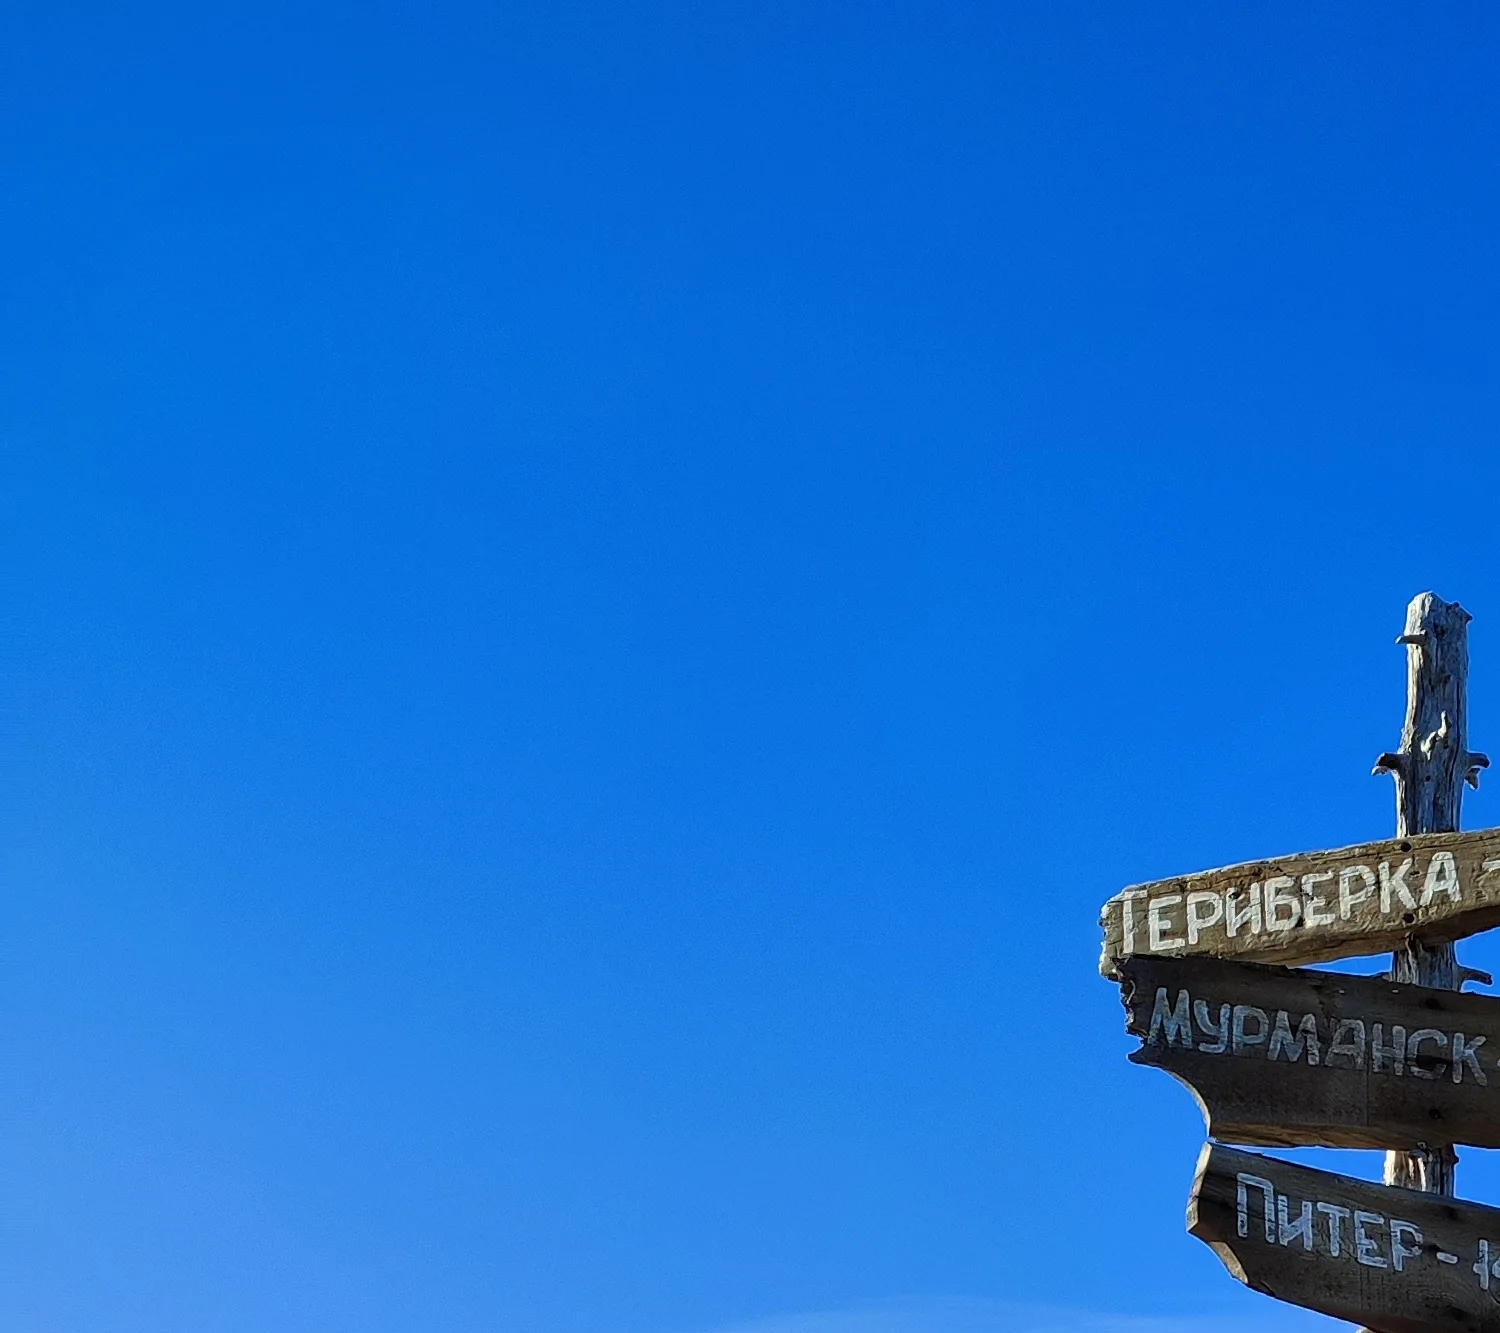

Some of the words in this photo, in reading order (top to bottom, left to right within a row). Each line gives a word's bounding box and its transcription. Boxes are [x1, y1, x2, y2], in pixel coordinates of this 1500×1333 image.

[1115, 852, 1462, 954] ТЕРИБЕРКА
[1147, 986, 1488, 1087] МУРМАНСК
[1236, 1173, 1424, 1272] ПИТЕР
